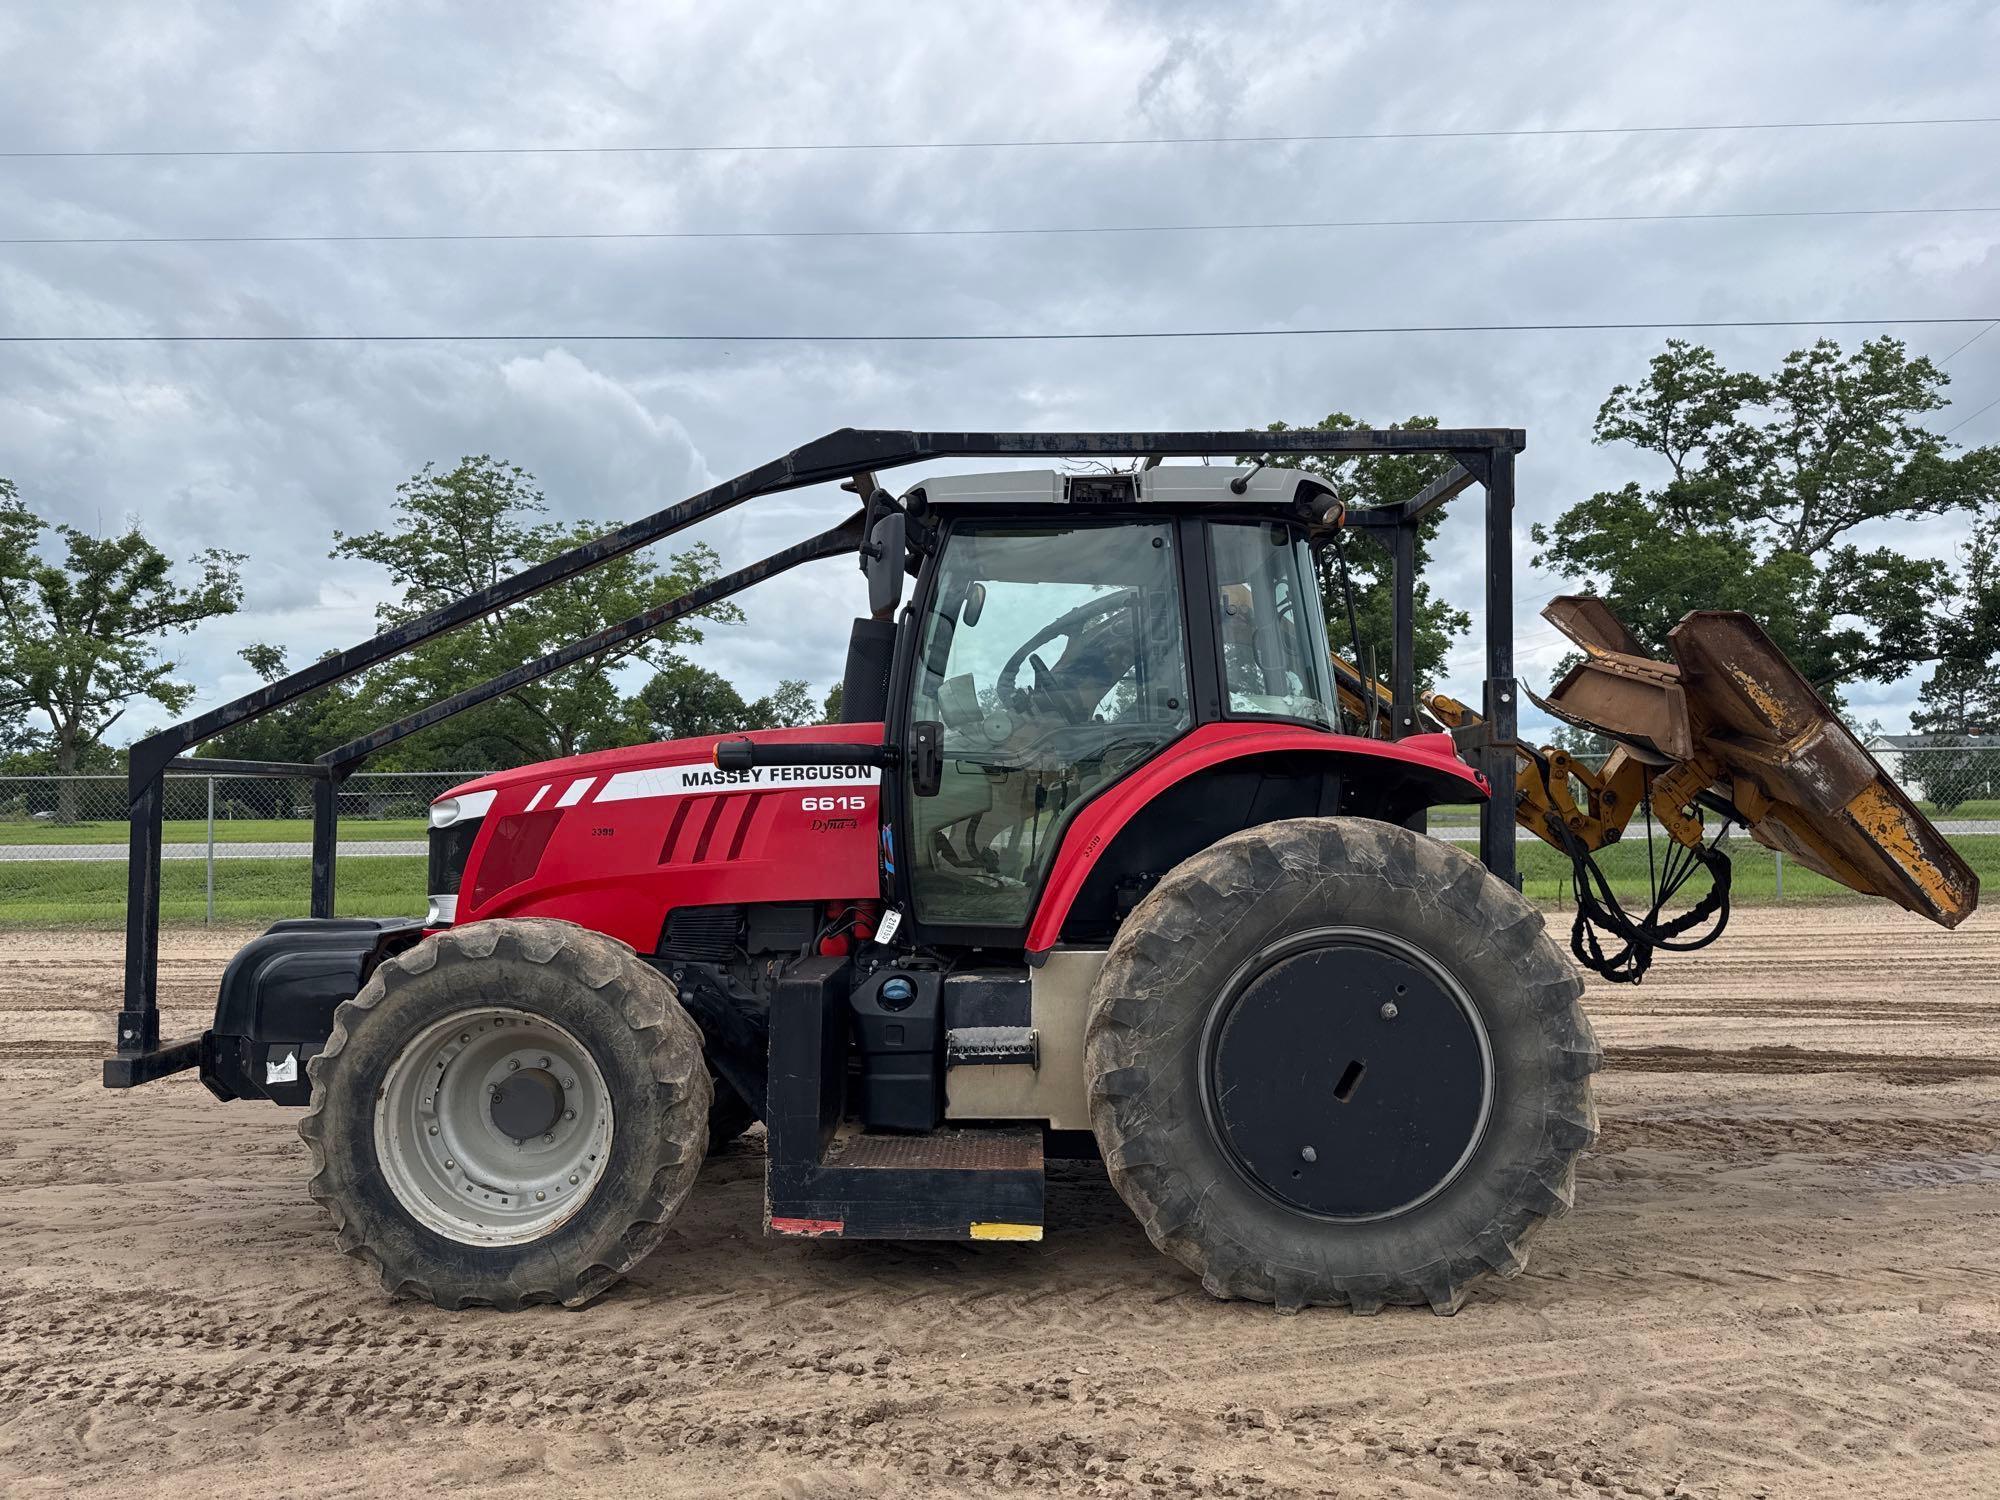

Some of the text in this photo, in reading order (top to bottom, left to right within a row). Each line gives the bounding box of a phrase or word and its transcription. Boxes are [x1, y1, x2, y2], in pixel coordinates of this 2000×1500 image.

[682, 766, 872, 787] MASSEY FERGUSON
[801, 796, 866, 811] 6615
[811, 818, 858, 834] Dyna-4
